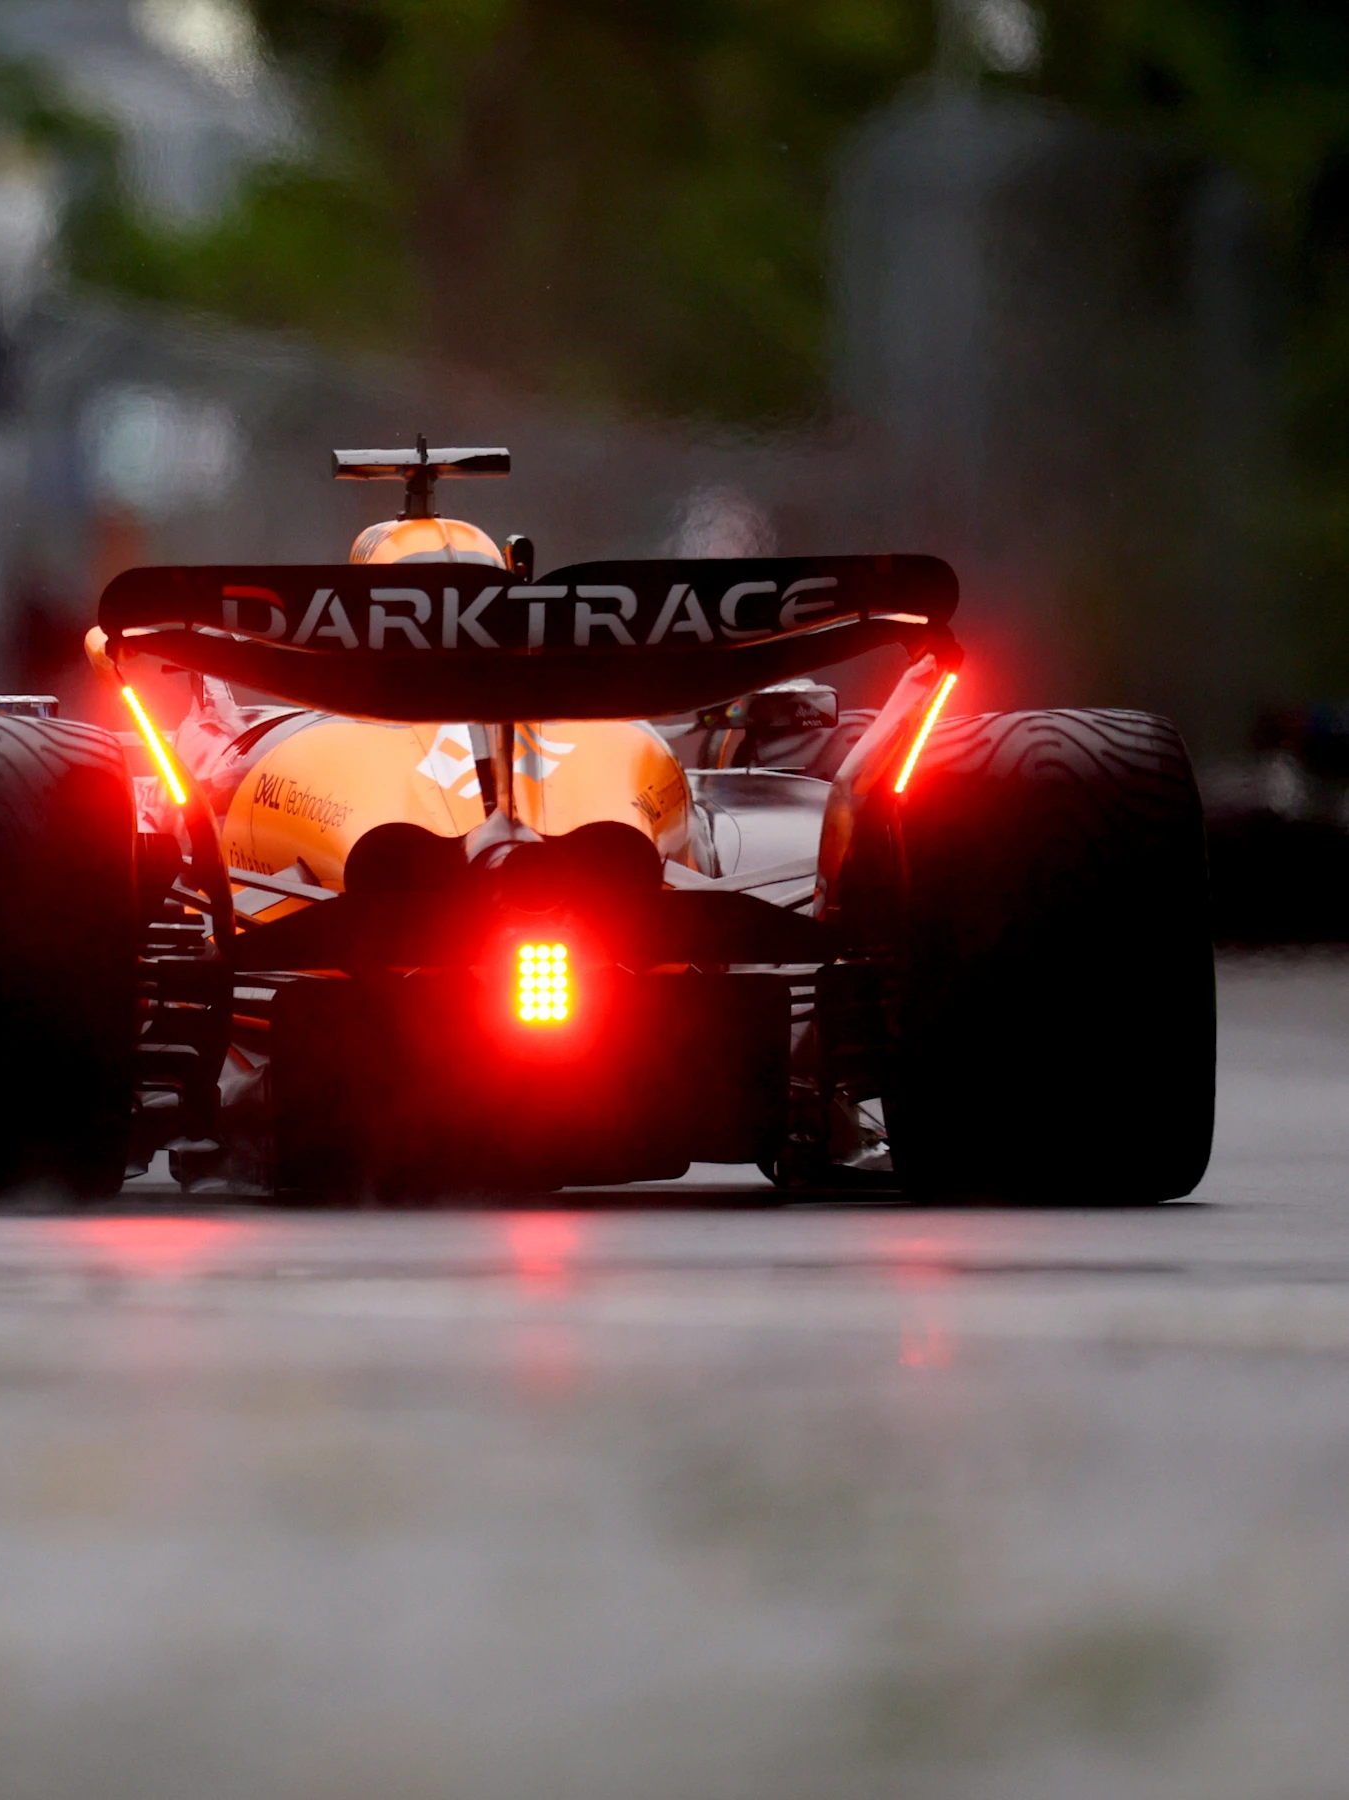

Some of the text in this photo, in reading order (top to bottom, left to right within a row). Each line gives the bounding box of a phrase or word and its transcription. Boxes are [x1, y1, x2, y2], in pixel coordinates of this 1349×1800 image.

[221, 576, 839, 650] DARKTRACE
[253, 772, 351, 833] DELL Technologies
